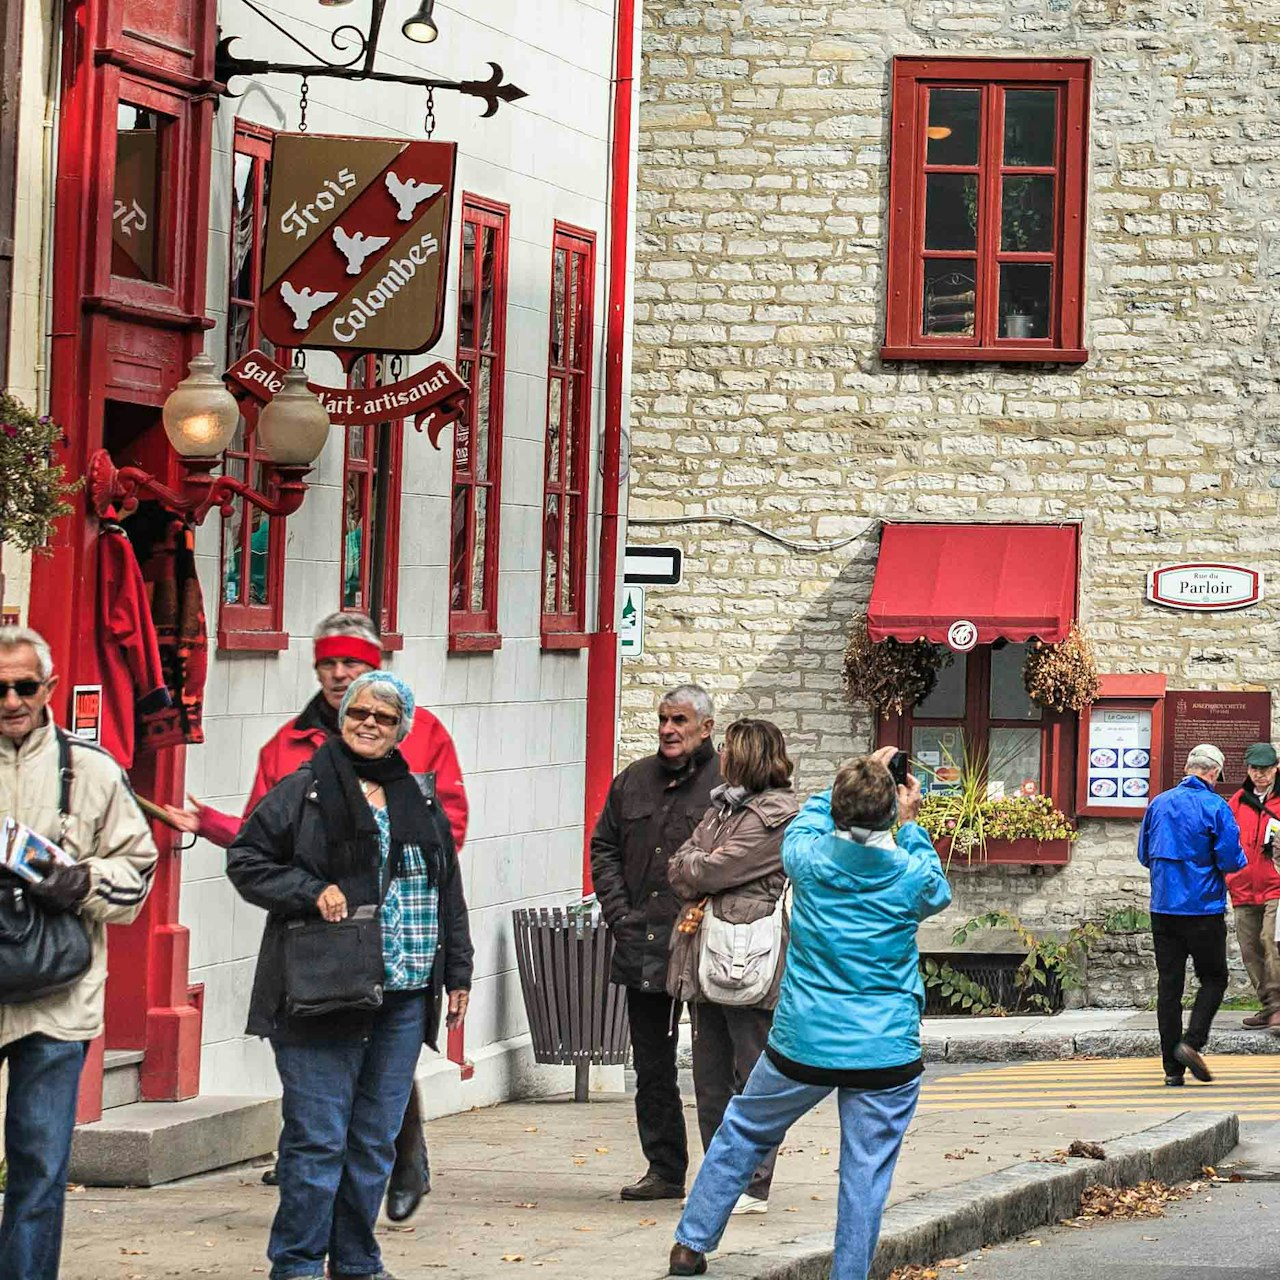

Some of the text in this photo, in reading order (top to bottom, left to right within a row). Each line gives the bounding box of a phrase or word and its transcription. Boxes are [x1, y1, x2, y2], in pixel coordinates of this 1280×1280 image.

[280, 167, 357, 241] Trois
[332, 232, 439, 343] Colombes
[236, 361, 286, 394] gale
[363, 368, 450, 415] artisanat
[1180, 580, 1233, 594] Parloir
[1193, 572, 1219, 580] Rue du
[938, 790, 954, 798] VISA
